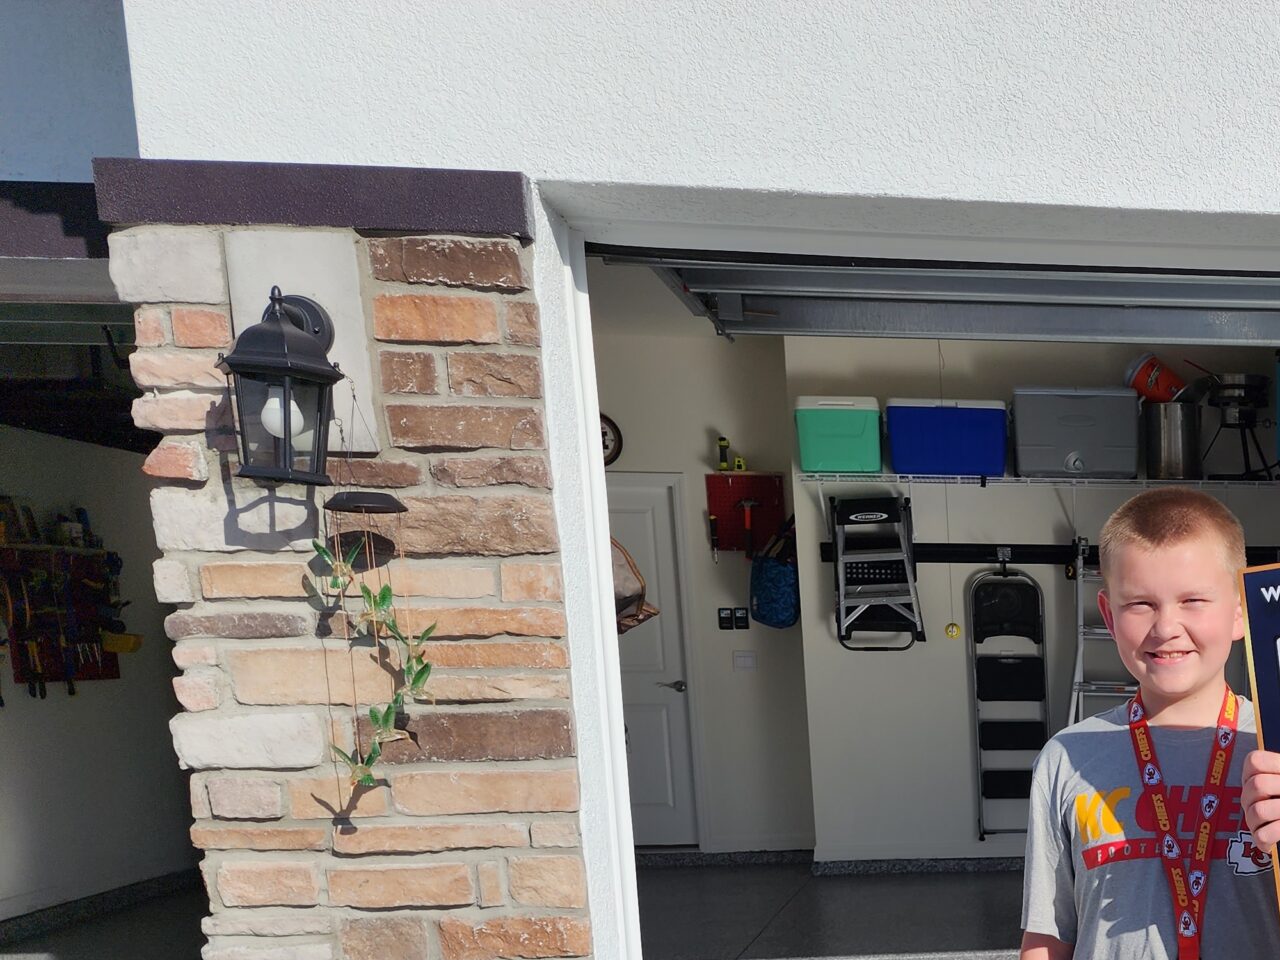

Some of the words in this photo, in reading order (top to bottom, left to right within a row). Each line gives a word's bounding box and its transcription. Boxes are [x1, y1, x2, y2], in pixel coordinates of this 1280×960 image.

[1135, 727, 1151, 760] CHIEFS
[1210, 750, 1226, 785] CHIEFS
[1075, 787, 1131, 844] KC
[1152, 794, 1170, 831] CHIEFS
[1195, 822, 1210, 861] CHIEFS
[1171, 867, 1188, 907] CHIEFS
